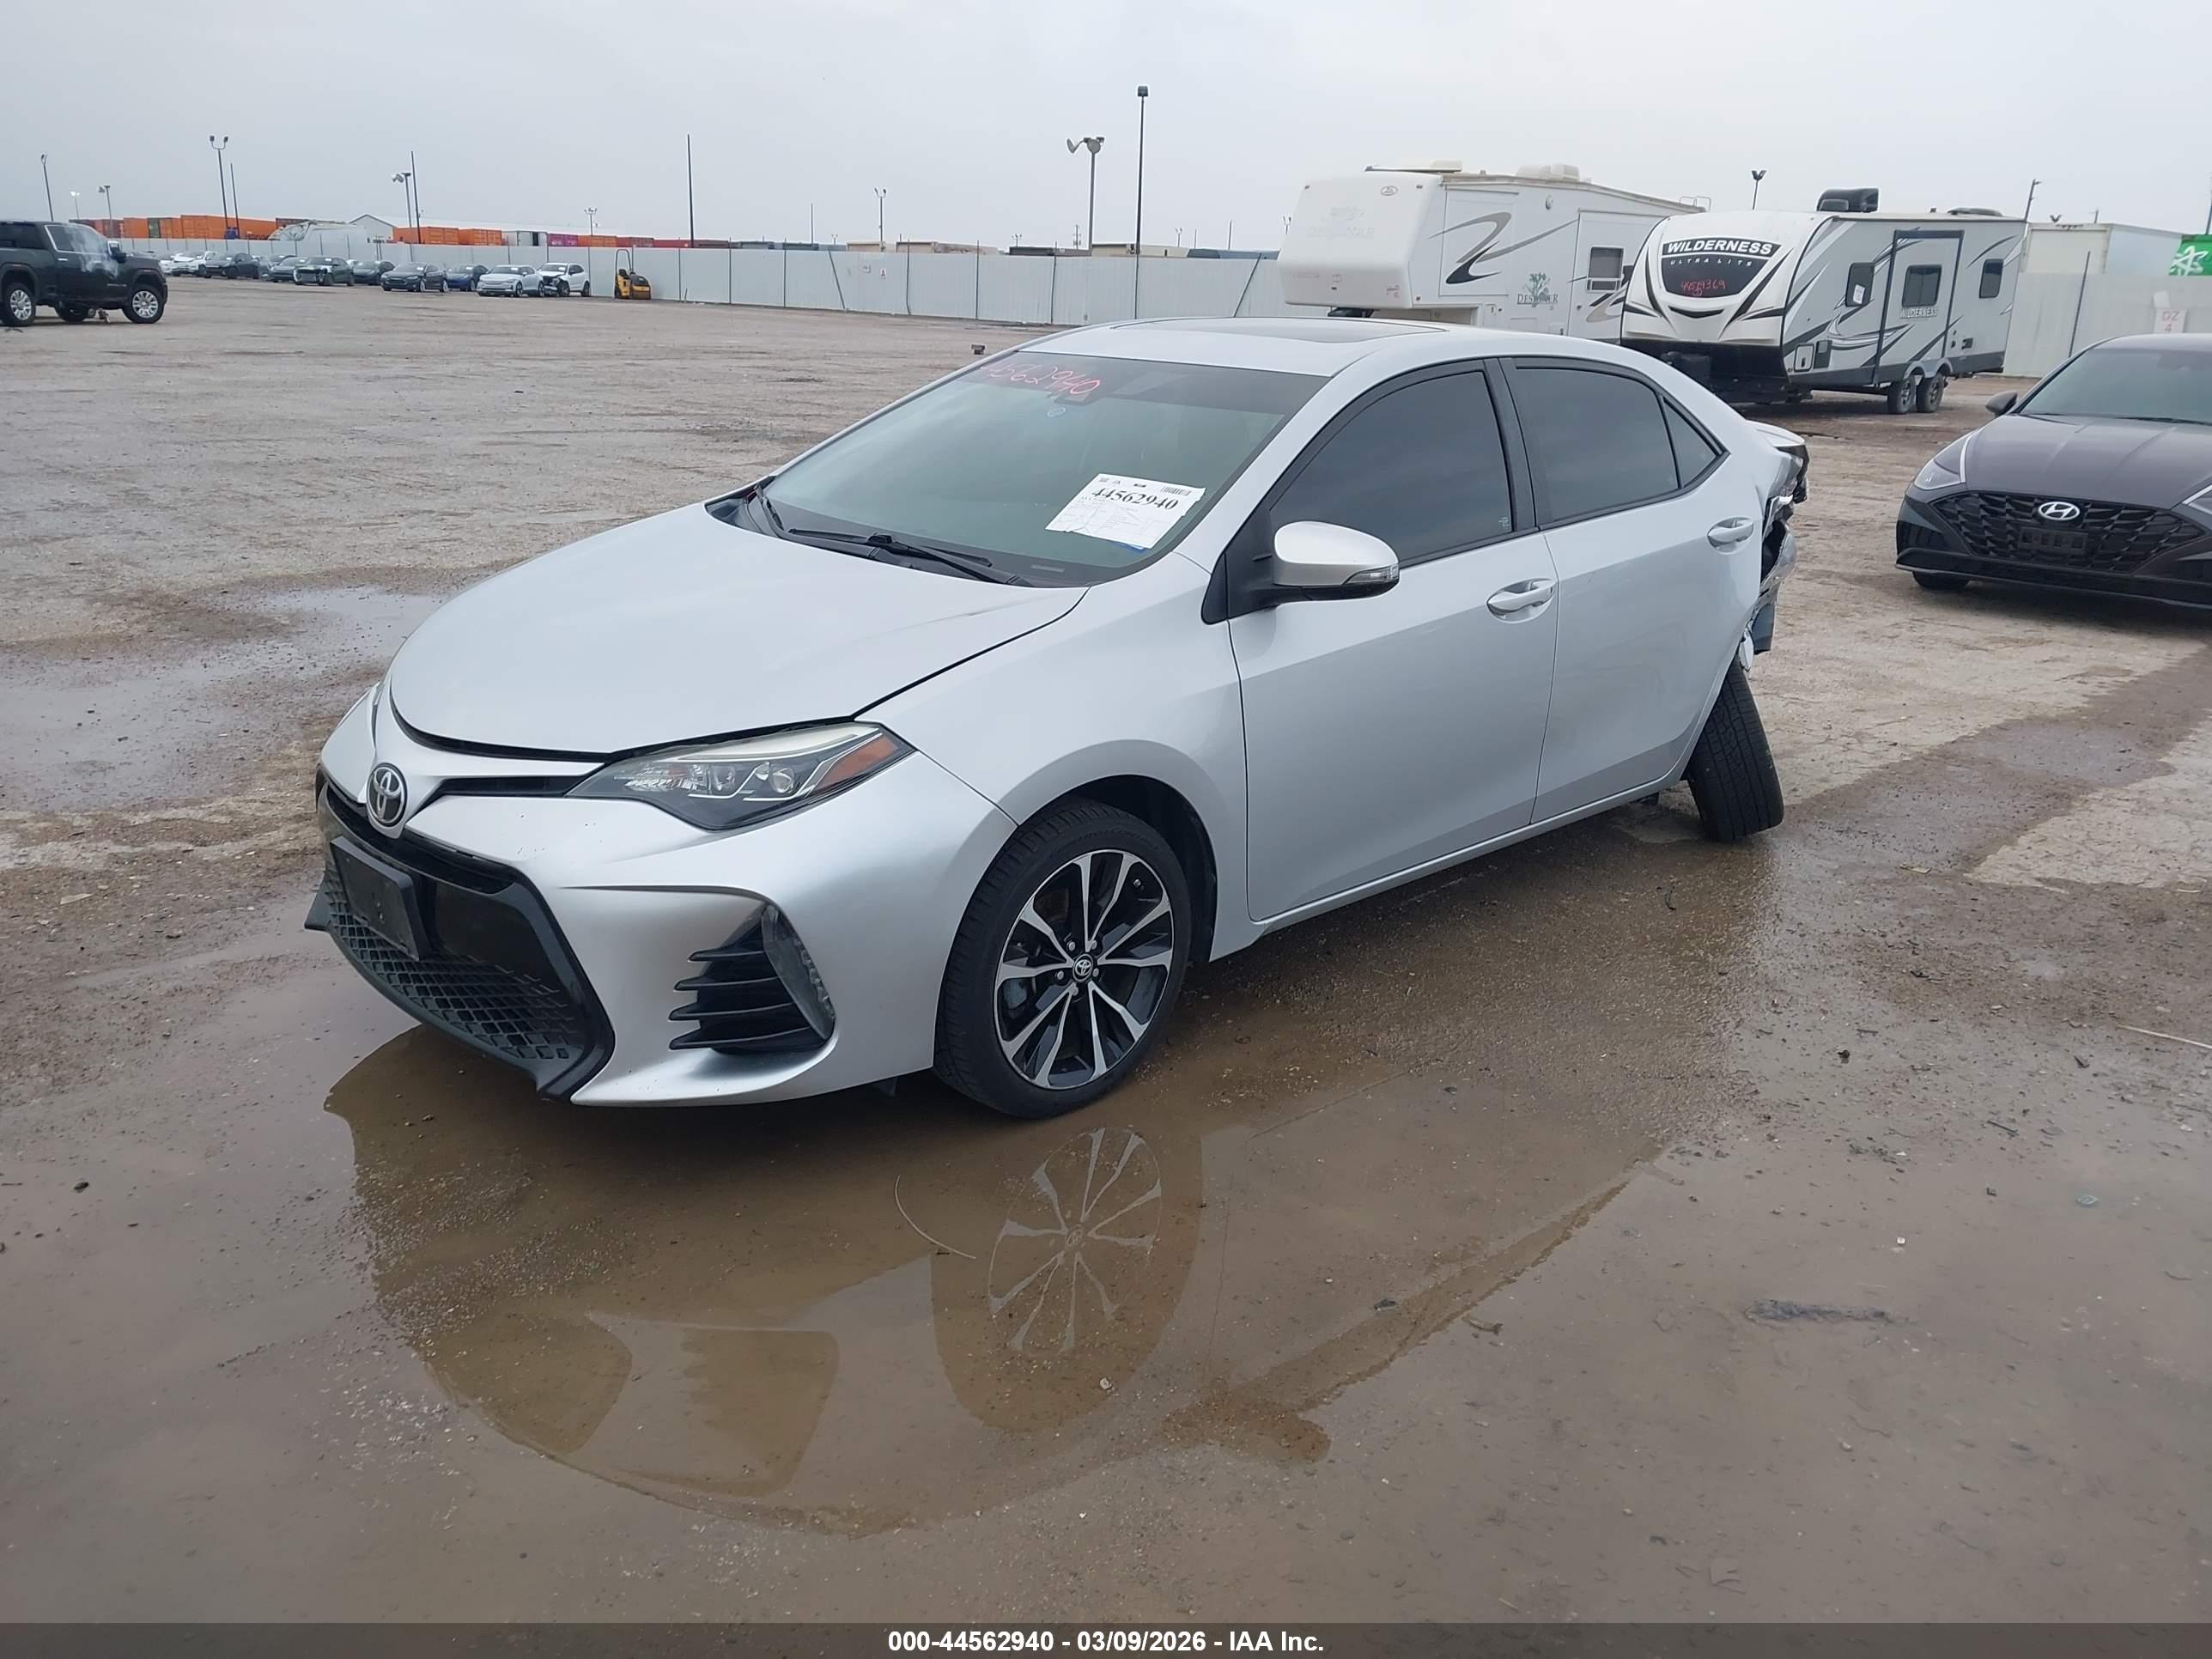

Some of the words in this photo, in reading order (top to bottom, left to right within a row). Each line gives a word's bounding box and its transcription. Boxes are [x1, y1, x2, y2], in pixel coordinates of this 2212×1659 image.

[1668, 240, 1773, 255] WILDERNESS
[1670, 257, 1710, 265] ULTRA
[1717, 258, 1753, 267] LITE
[1091, 487, 1180, 511] 44562940
